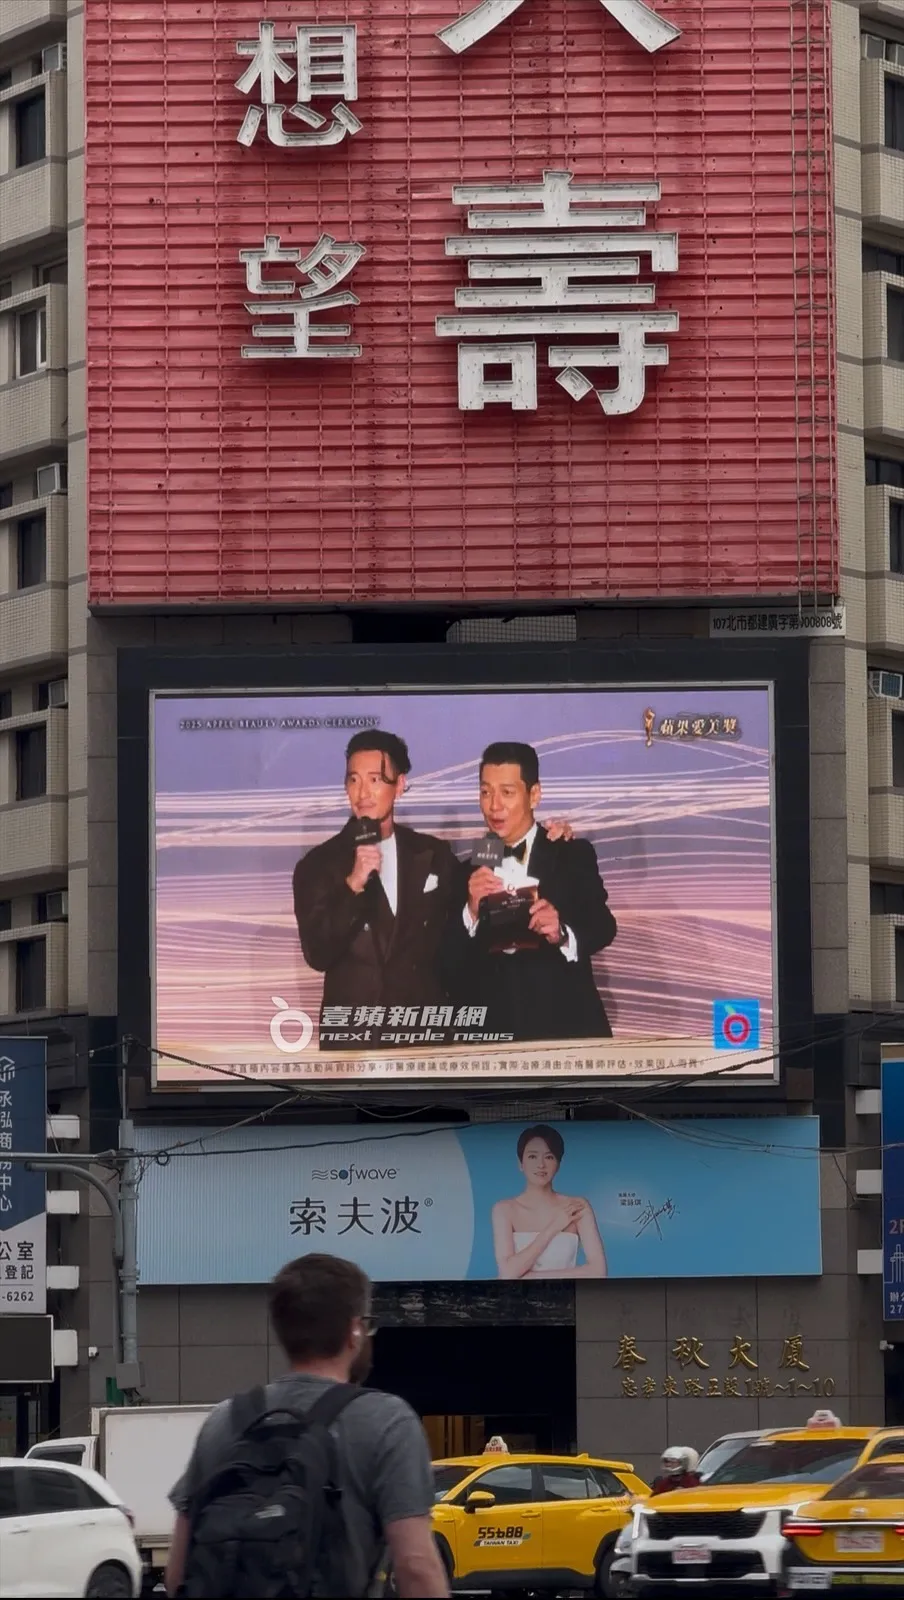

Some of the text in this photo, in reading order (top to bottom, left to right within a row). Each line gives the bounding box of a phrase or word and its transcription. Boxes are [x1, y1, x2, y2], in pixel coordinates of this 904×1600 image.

[206, 719, 235, 729] APPLE
[239, 718, 276, 728] BEAUTY
[280, 718, 320, 728] AWARDS
[324, 717, 379, 728] CEREMONY
[330, 1163, 397, 1186] sofwave
[612, 1334, 811, 1372] 春秋大廈
